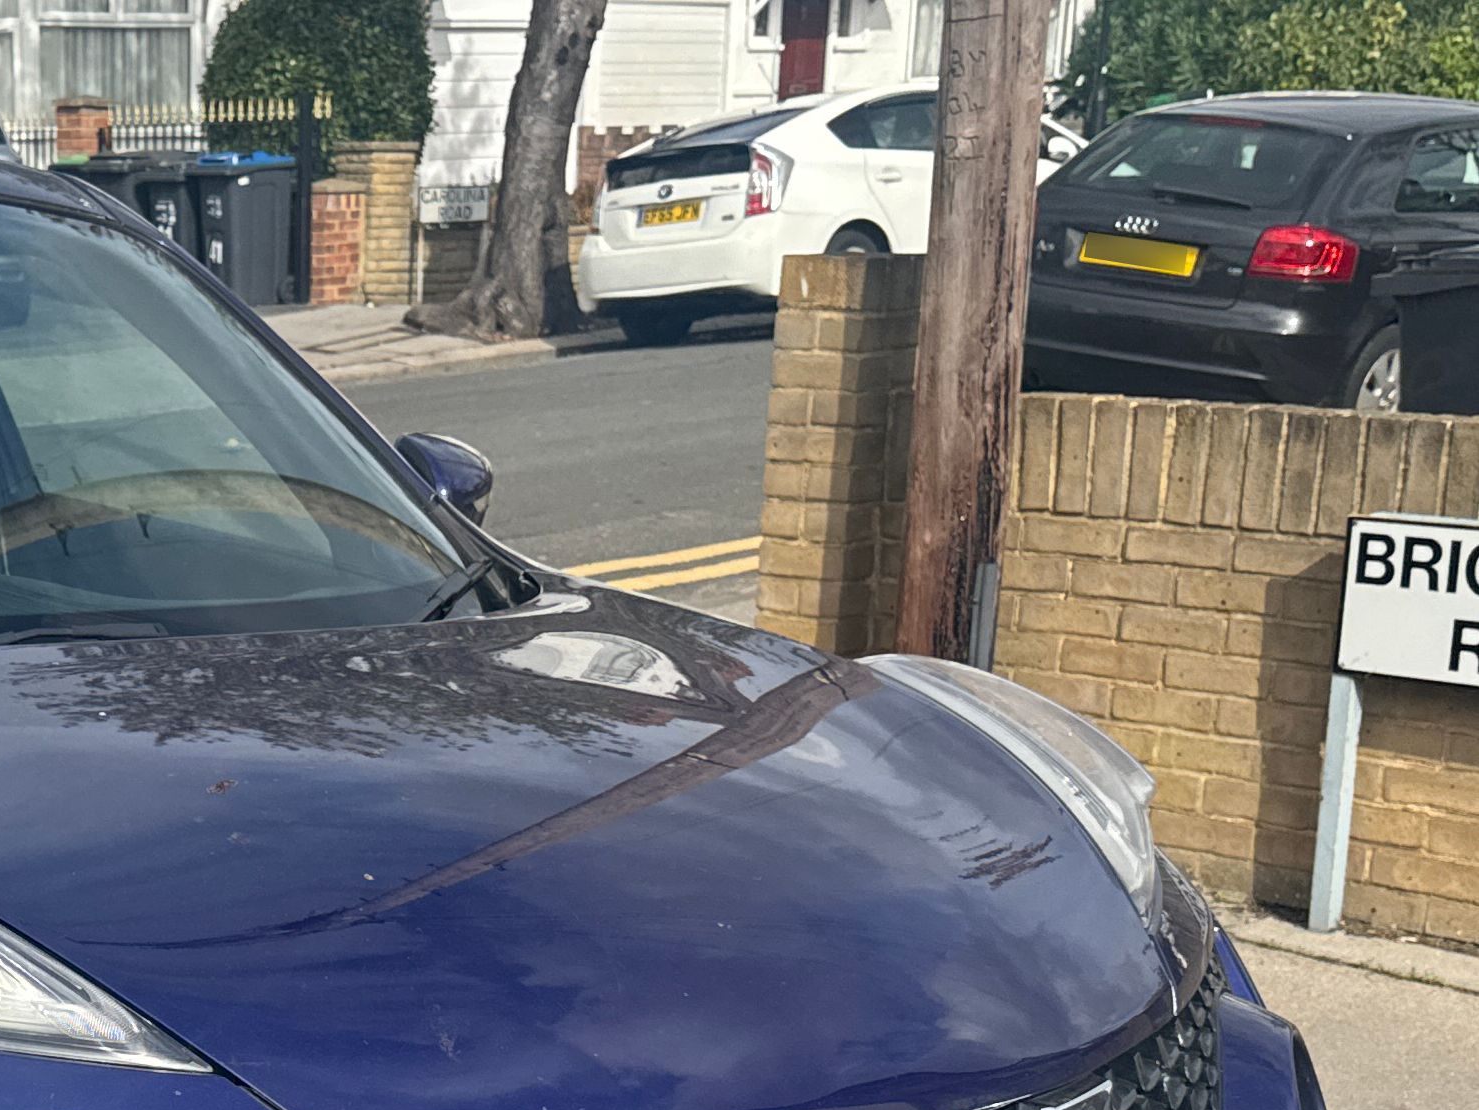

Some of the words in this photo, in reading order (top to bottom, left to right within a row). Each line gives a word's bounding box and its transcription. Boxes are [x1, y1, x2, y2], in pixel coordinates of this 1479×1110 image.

[421, 188, 486, 204] CAROLINA
[438, 205, 474, 220] ROAD
[1355, 532, 1479, 596] BRI
